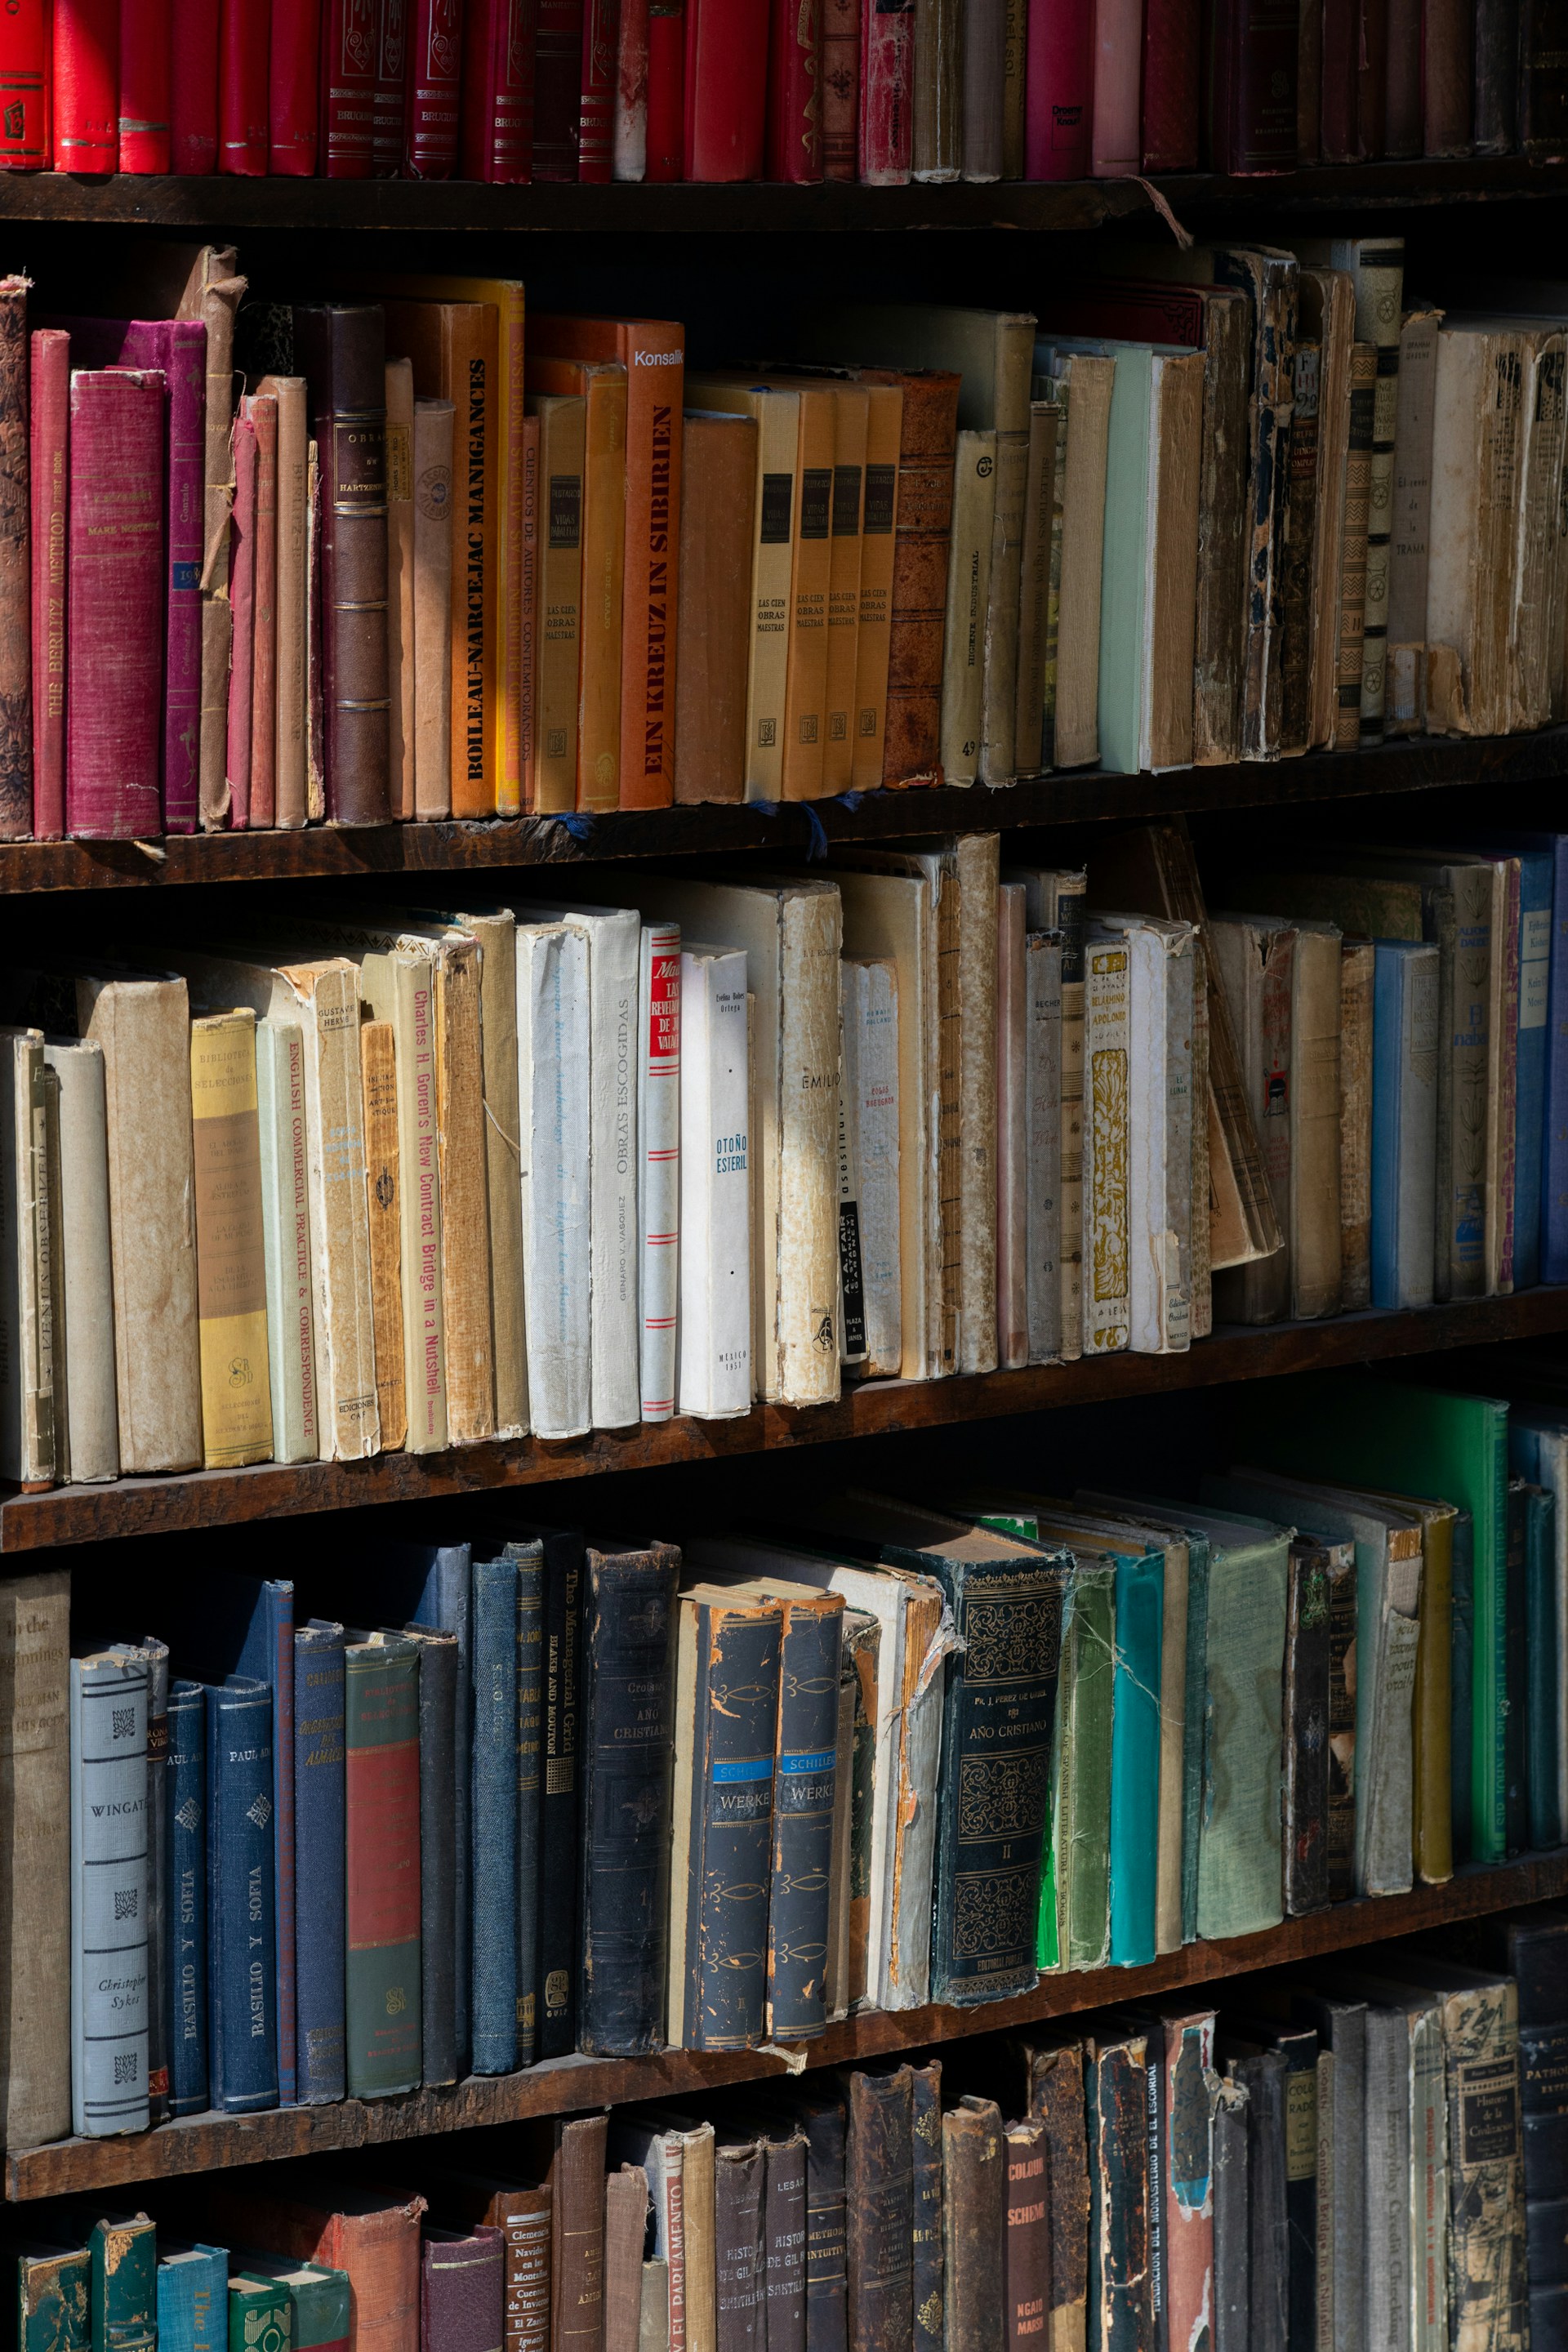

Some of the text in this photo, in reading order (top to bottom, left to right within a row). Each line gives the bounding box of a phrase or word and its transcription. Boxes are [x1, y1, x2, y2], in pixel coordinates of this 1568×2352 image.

[635, 350, 684, 367] Konsalik
[511, 341, 524, 434] INGLESAS
[510, 446, 523, 520] ALDEAS
[179, 482, 189, 523] Gonzalo
[1409, 498, 1419, 510] de
[1036, 457, 1049, 584] SELECTIONS FROM
[523, 447, 536, 615] CUENTOS DE AUTORES
[510, 529, 522, 566] LAS
[1397, 542, 1425, 555] TRAMA
[467, 359, 486, 781] BOILEAU-NARCEJAC MANIGANCES
[50, 450, 65, 719] THE BERLITZ METHOD FIRST BOOK
[604, 574, 612, 589] DE
[644, 404, 672, 775] EIN KREUZ IN SIBIRIEN
[797, 594, 824, 604] LAS CIEN
[829, 592, 856, 602] LAS CIEN
[861, 589, 887, 598] LAS CIEN
[548, 606, 577, 615] LAS CIEN
[759, 599, 786, 608] LAS CIEN
[797, 607, 824, 615] OBRAS
[829, 604, 856, 613] OBRAS
[860, 601, 887, 609] OBRAS
[968, 550, 980, 666] HIGIENE INDUSTRIAL
[547, 618, 576, 627] OBRAS
[758, 612, 785, 620] OBRAS
[797, 618, 824, 628] MAESTRAS
[828, 616, 856, 626] MAESTRAS
[859, 612, 886, 622] MAESTRAS
[546, 630, 576, 640] MAESTRAS
[757, 623, 785, 632] MAESTRAS
[507, 682, 521, 761] EDMUND
[962, 740, 976, 756] 49
[1036, 999, 1061, 1009] BECHER
[1092, 992, 1125, 1006] BELARMINO
[318, 1005, 355, 1018] GUSTAVE
[1092, 1012, 1126, 1026] APOLONIO
[659, 1018, 670, 1033] DE
[200, 1049, 251, 1064] BIBLIOTECA
[225, 1065, 234, 1074] de
[195, 1075, 253, 1089] SELECCIONES
[617, 999, 629, 1174] OBRAS ESCOGIDAS
[801, 1071, 842, 1089] EMILIO
[716, 1134, 747, 1154] OTOÑO
[716, 1156, 747, 1174] ESTERIL
[414, 991, 441, 1435] Charles H. Goren's New Contract Bridge in a Nutshell Doubleday
[290, 1042, 314, 1437] ENGLISH COMMERCIAL PRACTICE & CORRESPONDENCE
[840, 1214, 848, 1252] FAIR
[38, 1145, 52, 1352] VENUS OBSERVED
[618, 1195, 627, 1301] GENARO V. VASQUEZ
[846, 1317, 862, 1325] PLAZA
[1169, 1331, 1188, 1340] MEXICO
[719, 1350, 746, 1363] MEXICO
[339, 1399, 376, 1414] EDICIONES
[1495, 1443, 1508, 1513] INGLESA
[1494, 1521, 1508, 1628] AGRICULTURA
[26, 1617, 50, 1635] the
[562, 1569, 579, 1754] The Managerial Grid
[547, 1634, 559, 1755] BLAKE AND MOUTON
[995, 1694, 1018, 1704] PEREZ
[969, 1719, 1047, 1740] AÑO CRISTIANO
[229, 1750, 257, 1763] PAUL
[1495, 1757, 1507, 1795] JOHN
[720, 1792, 769, 1810] WERKE
[791, 1783, 834, 1802] WERKE
[1058, 1682, 1071, 1927] HISTORY OF SPANISH LITERATURE BOGGS
[181, 1869, 197, 2040] BASILIO Y SOFIA
[248, 1865, 265, 2038] BASILIO Y SOFIA
[98, 1977, 147, 1993] Christopher
[111, 1993, 140, 2011] Sykes
[1147, 2062, 1158, 2114] ESCORIAL
[1147, 2118, 1158, 2131] EL
[1148, 2134, 1159, 2149] DE
[1384, 2108, 1402, 2193] Everyday
[1008, 2157, 1044, 2182] COLOUR
[1149, 2154, 1160, 2223] MONASTERIO
[1007, 2201, 1045, 2226] SCHEME
[1388, 2199, 1402, 2254] Credit
[1151, 2226, 1160, 2247] DEL
[1317, 2138, 1330, 2345] Contract Bridge in a Nutshell
[522, 2260, 532, 2269] en
[670, 2185, 685, 2336] EL PARLAMENTO
[767, 2252, 798, 2270] DE GIL
[508, 2301, 519, 2311] de
[1017, 2297, 1043, 2319] NGAIO
[1388, 2260, 1402, 2346] Checking
[514, 2319, 523, 2329] El
[1017, 2315, 1044, 2336] MARSH
